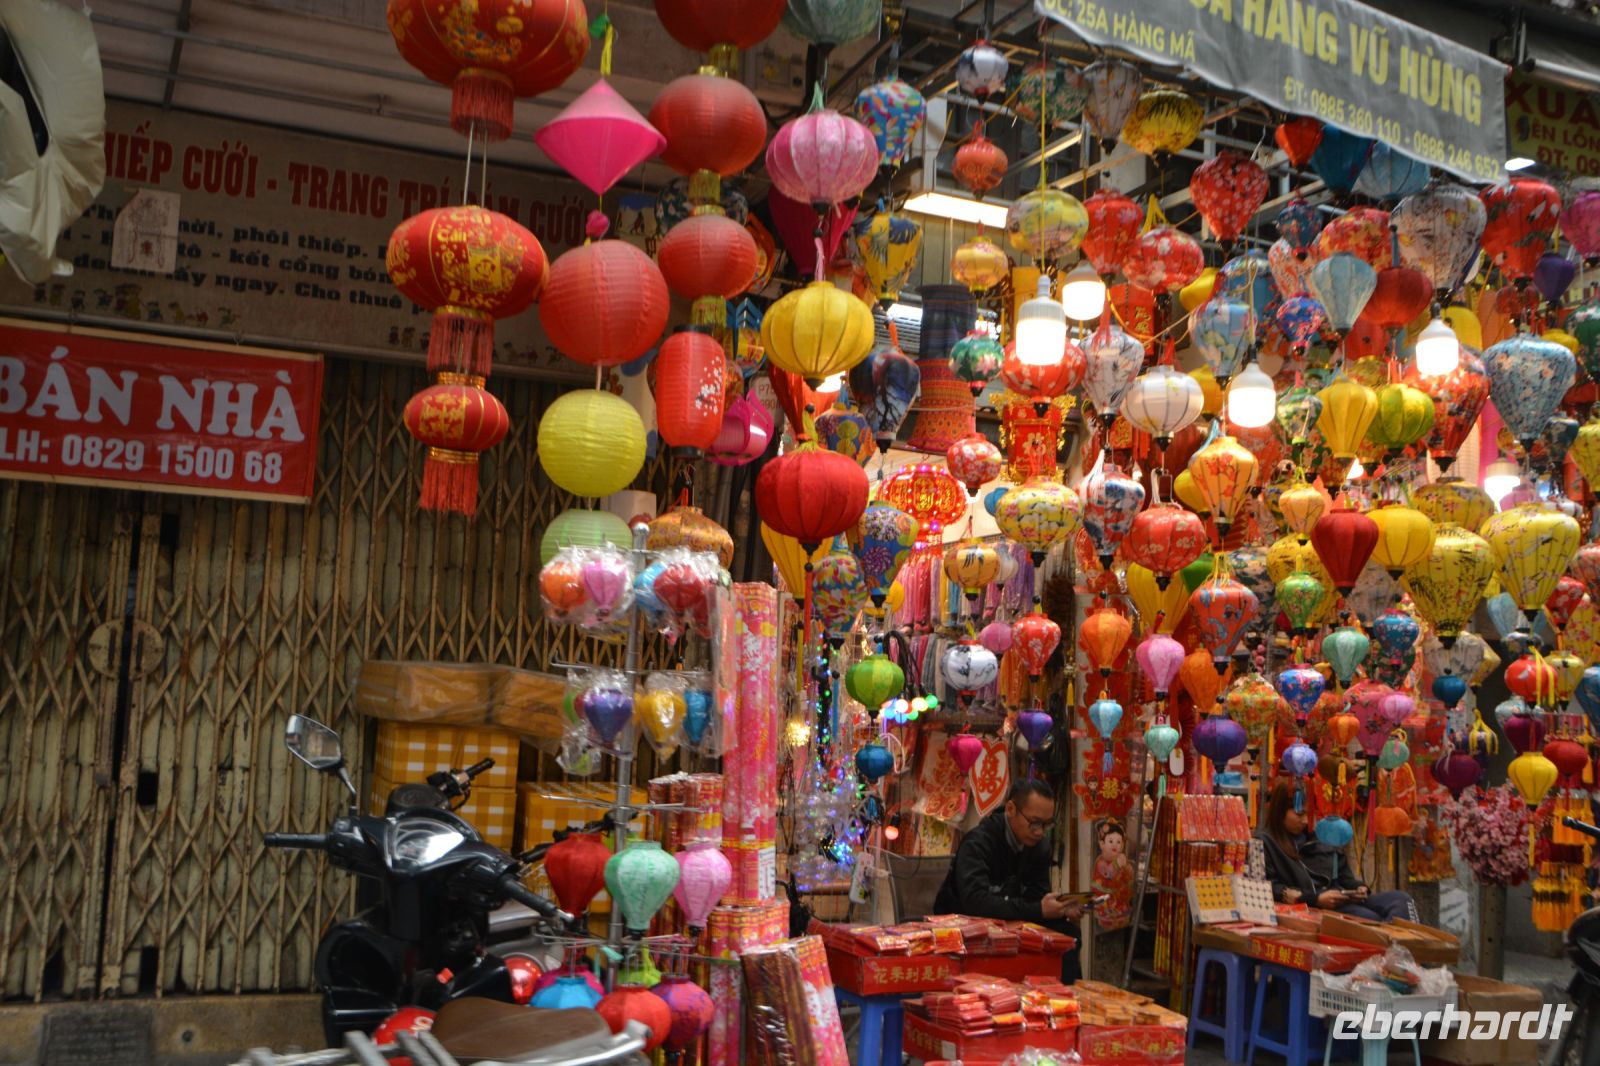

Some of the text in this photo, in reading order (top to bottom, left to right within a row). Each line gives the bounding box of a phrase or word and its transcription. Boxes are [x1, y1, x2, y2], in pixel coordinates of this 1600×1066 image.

[1077, 0, 1109, 34] 25A
[1113, 9, 1166, 51] HÀNG
[1169, 29, 1196, 62] MÃ
[1350, 23, 1390, 85] VŨ
[1399, 46, 1482, 126] HÙNG
[1311, 89, 1345, 123] 0985
[1348, 104, 1374, 135] 360
[1376, 116, 1401, 145] 110
[1413, 130, 1445, 163] 0986
[1447, 143, 1473, 174] 246
[182, 140, 258, 198] CƯỚI
[288, 162, 389, 219] TRANG
[294, 282, 341, 300] Cho
[0, 346, 305, 443] BÁN NHÀ
[0, 427, 283, 485] LH: 0829 1500 68
